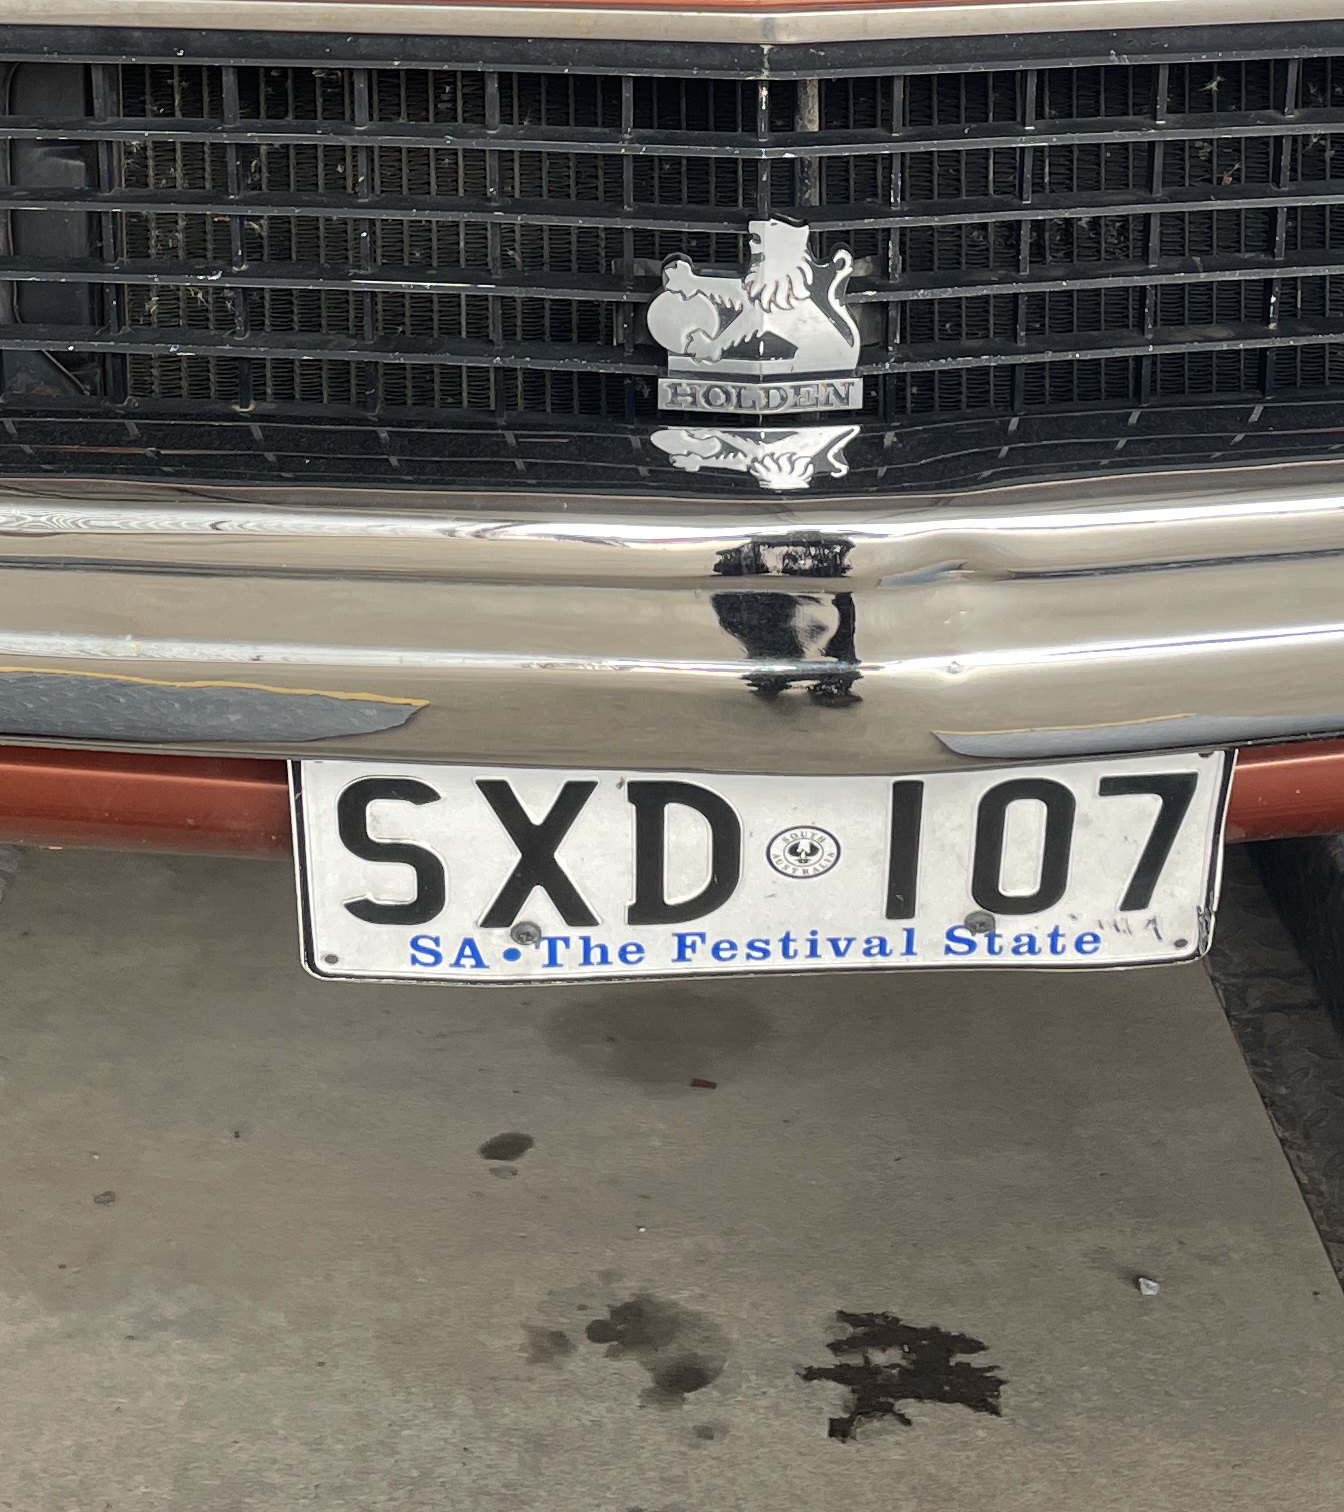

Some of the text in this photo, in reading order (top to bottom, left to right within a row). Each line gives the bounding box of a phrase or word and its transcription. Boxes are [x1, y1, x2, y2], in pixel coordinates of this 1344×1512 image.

[664, 381, 855, 410] HOLDEN
[336, 771, 1198, 928] SXD 107
[781, 830, 827, 844] SOUTH
[771, 851, 835, 875] AUSTRALIA
[671, 927, 918, 963] Festival
[944, 924, 1102, 956] State
